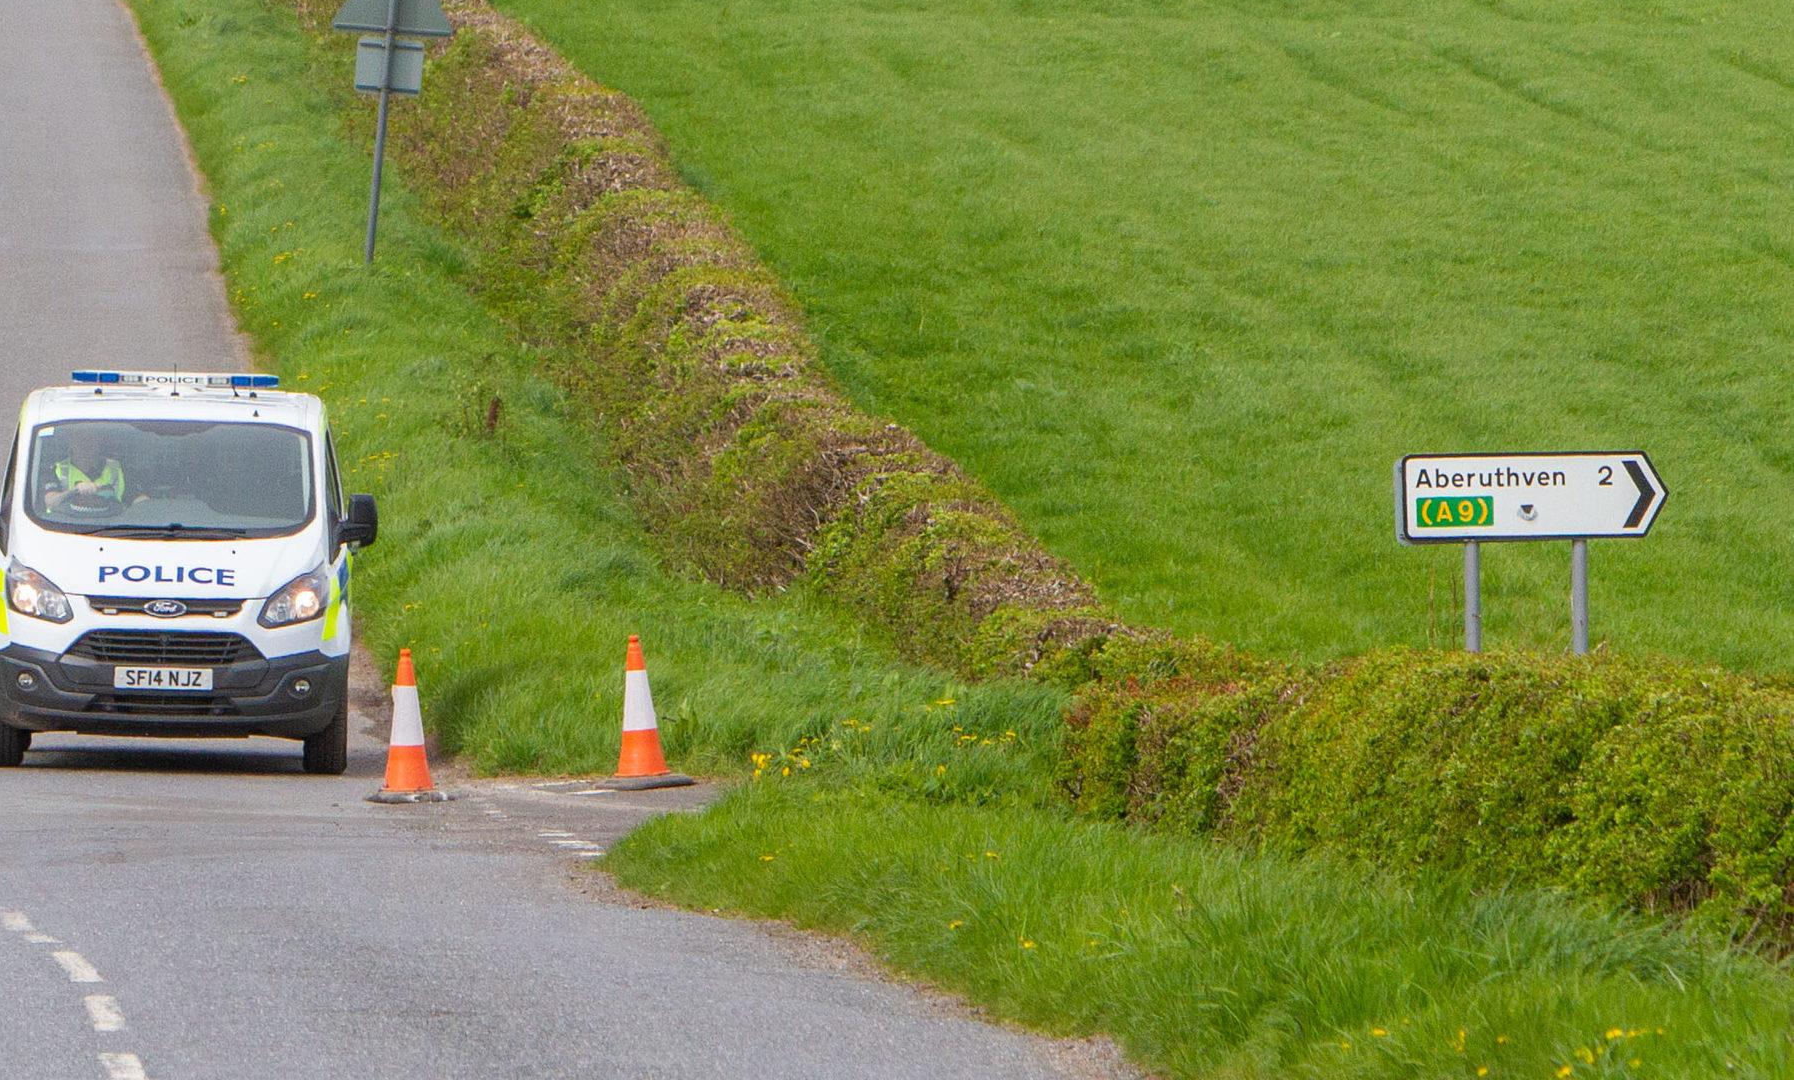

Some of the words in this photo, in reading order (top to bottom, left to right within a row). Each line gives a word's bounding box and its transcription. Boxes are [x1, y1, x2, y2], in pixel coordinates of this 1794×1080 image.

[145, 375, 204, 384] POLICE
[1416, 466, 1566, 488] Aberuthven
[1597, 465, 1613, 486] 2
[1421, 498, 1488, 525] (A9)
[98, 564, 235, 586] POLICE
[153, 602, 177, 612] Ford
[125, 670, 163, 686] SF14
[169, 671, 202, 687] NJZ
